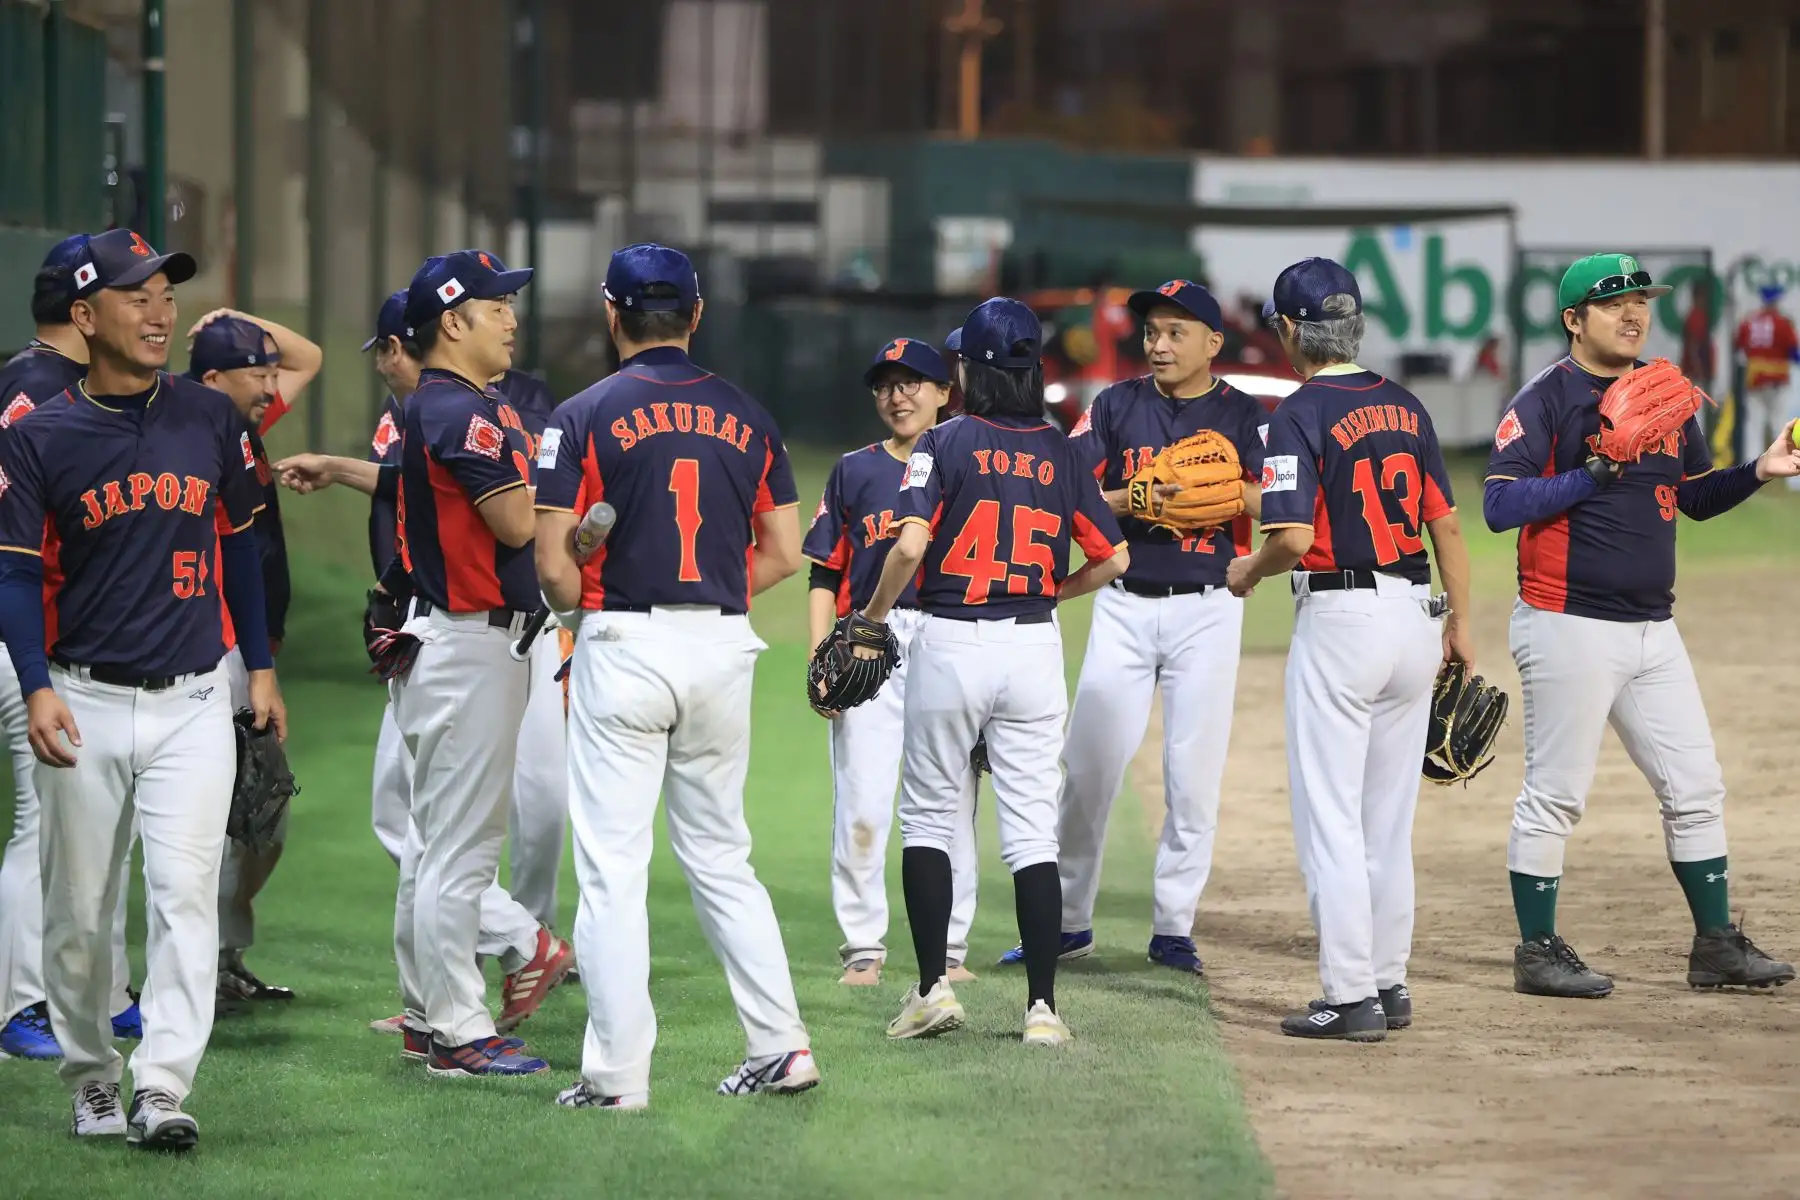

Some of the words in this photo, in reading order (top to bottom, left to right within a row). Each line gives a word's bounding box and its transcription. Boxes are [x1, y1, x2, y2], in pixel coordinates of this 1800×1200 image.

[885, 338, 909, 361] J
[611, 402, 753, 453] SAKURAI
[973, 449, 1054, 486] YOKO
[80, 472, 210, 530] JAPON
[668, 458, 703, 582] 1
[1353, 452, 1426, 567] 13
[1654, 484, 1679, 522] 9
[940, 499, 1063, 605] 45
